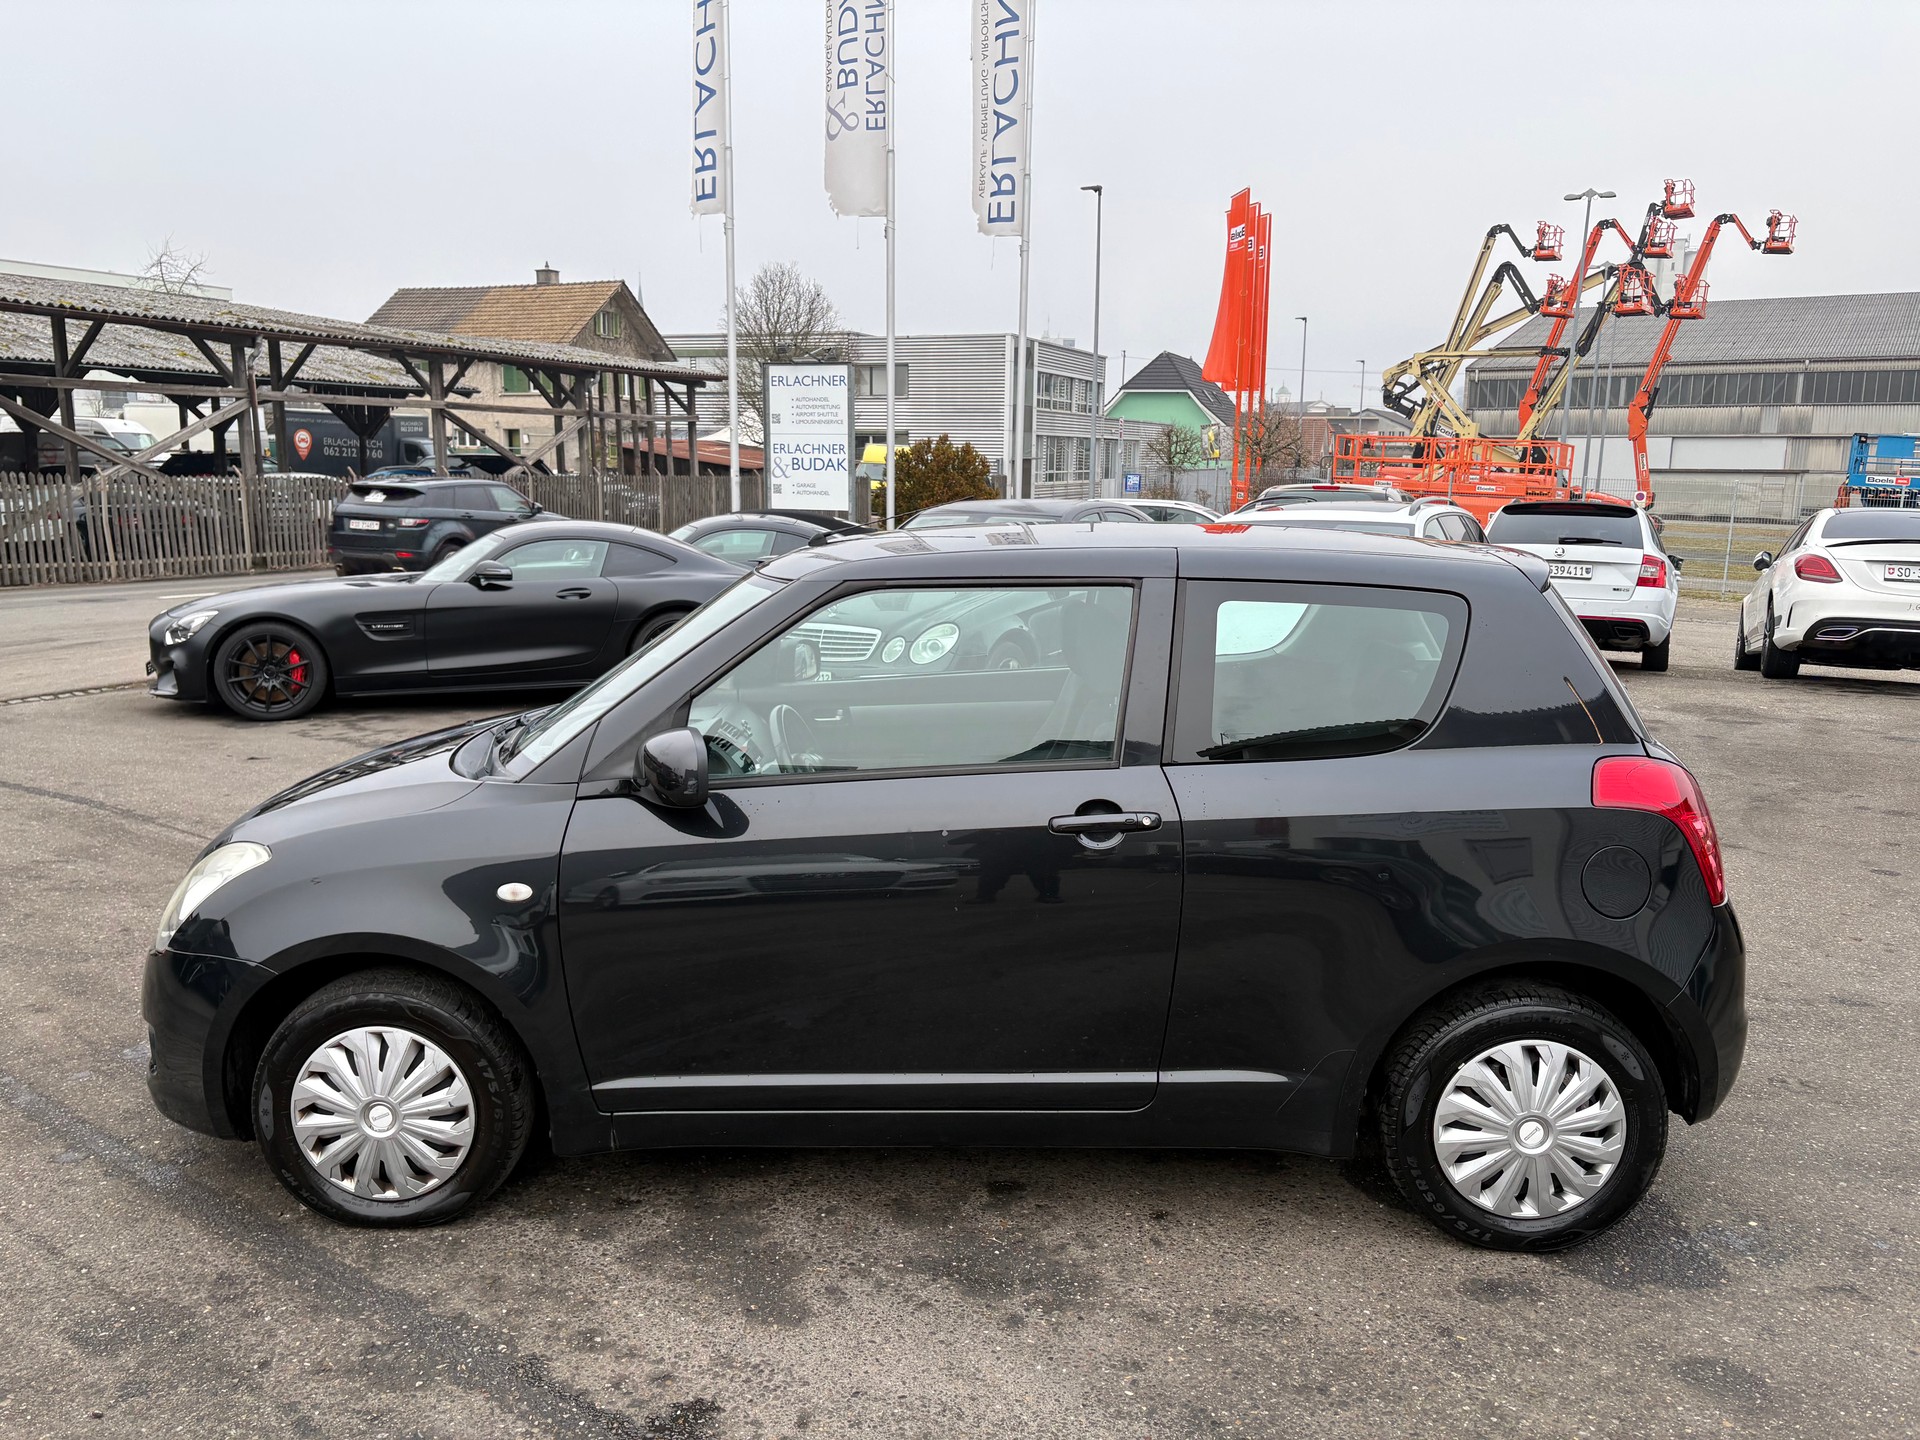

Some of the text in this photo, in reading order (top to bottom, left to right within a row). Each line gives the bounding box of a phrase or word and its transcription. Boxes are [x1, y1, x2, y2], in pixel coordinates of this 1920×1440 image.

[771, 375, 847, 387] ERLACHNER
[323, 446, 340, 456] 062
[342, 447, 357, 457] 212
[371, 449, 383, 459] 60
[773, 443, 847, 455] ERLACHNER
[772, 456, 847, 479] & BUDAK
[1867, 476, 1894, 484] Boels
